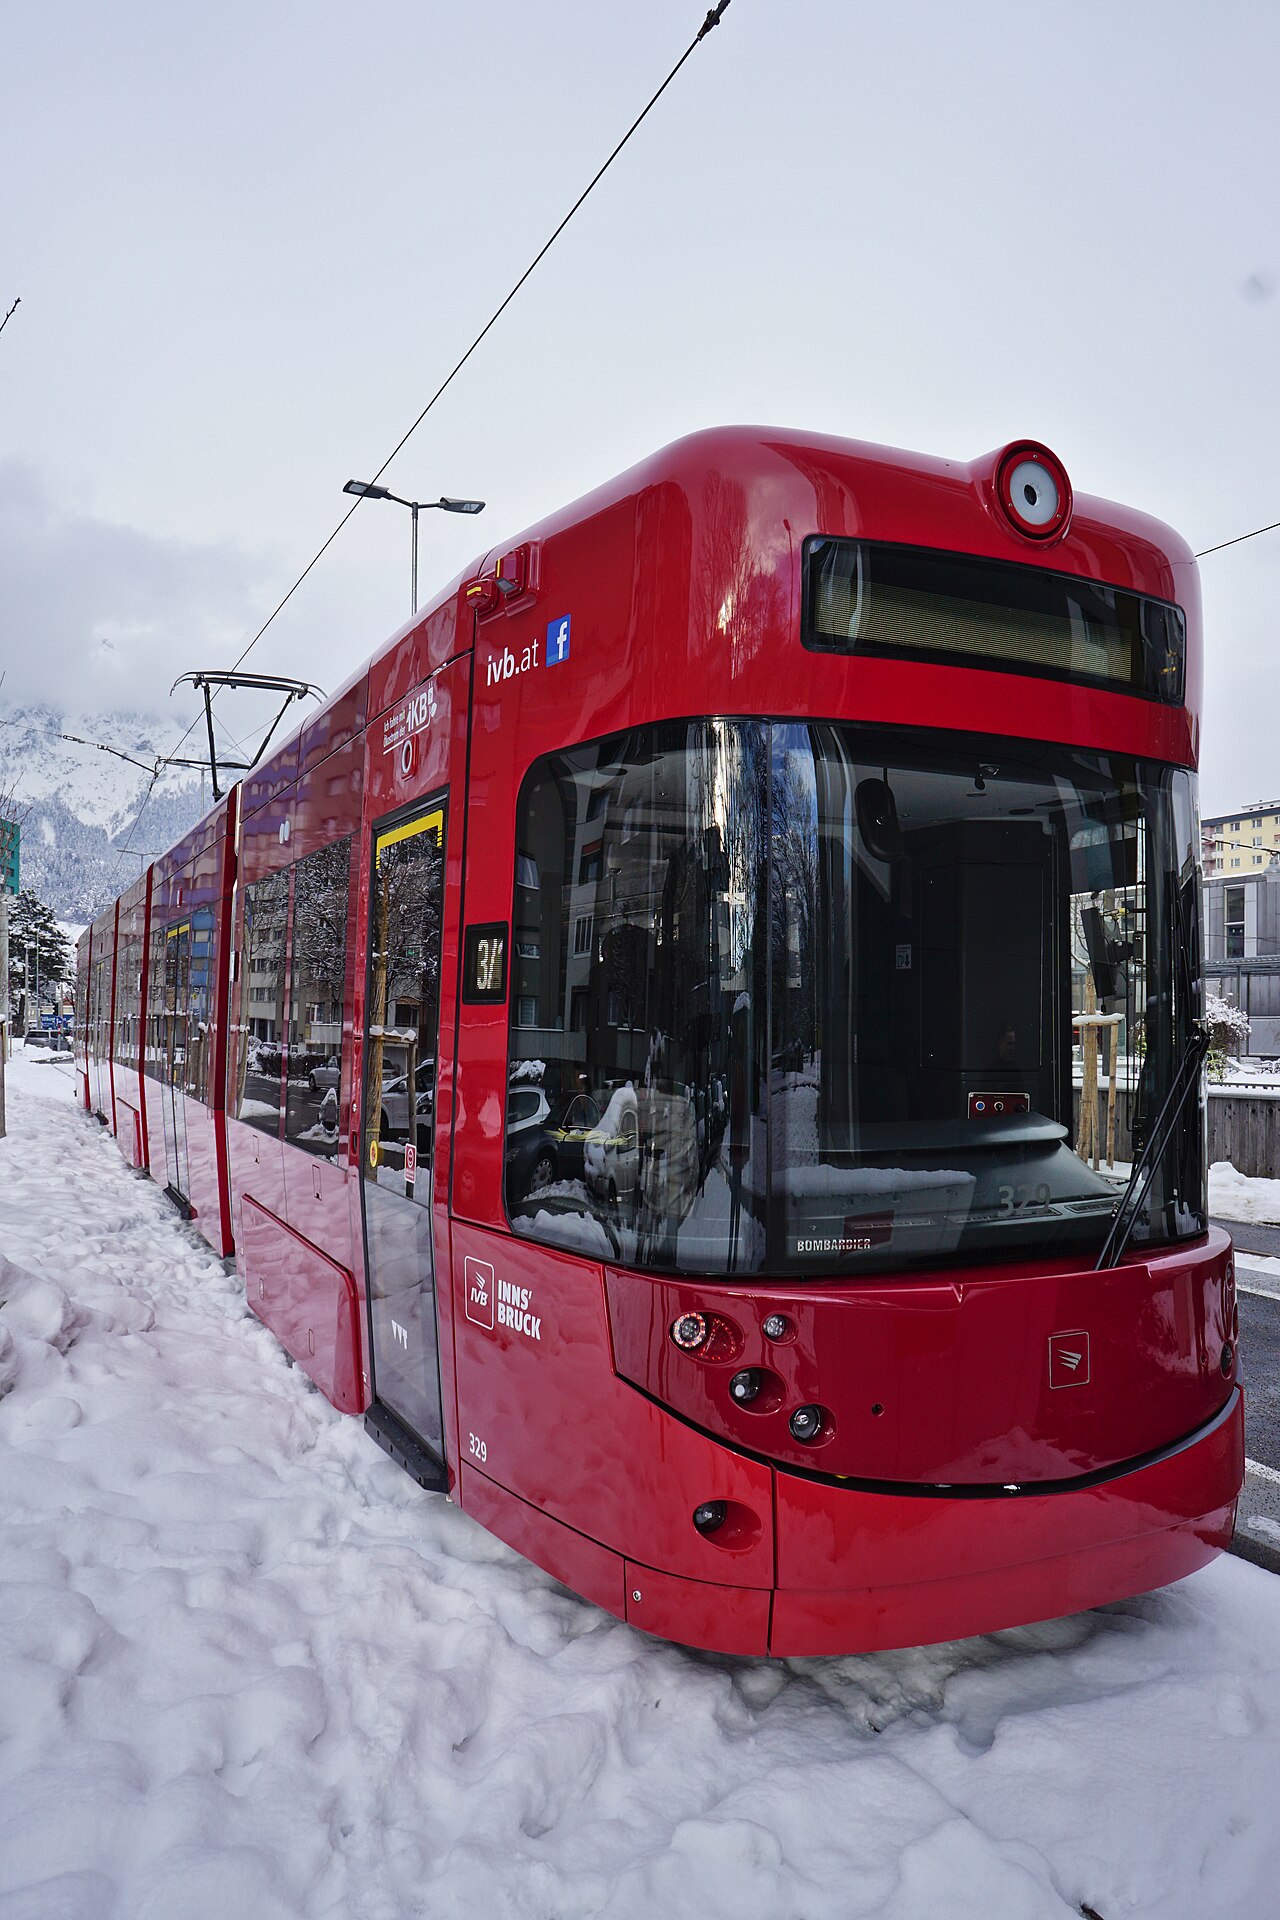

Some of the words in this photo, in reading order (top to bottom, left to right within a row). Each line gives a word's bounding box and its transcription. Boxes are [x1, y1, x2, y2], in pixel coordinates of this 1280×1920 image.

[487, 638, 540, 687] ivb.at
[998, 1183, 1051, 1218] 329
[797, 1238, 871, 1252] BOMBARDIER
[470, 1287, 488, 1307] IVB
[497, 1301, 542, 1341] BRUCK
[469, 1432, 487, 1463] 329
